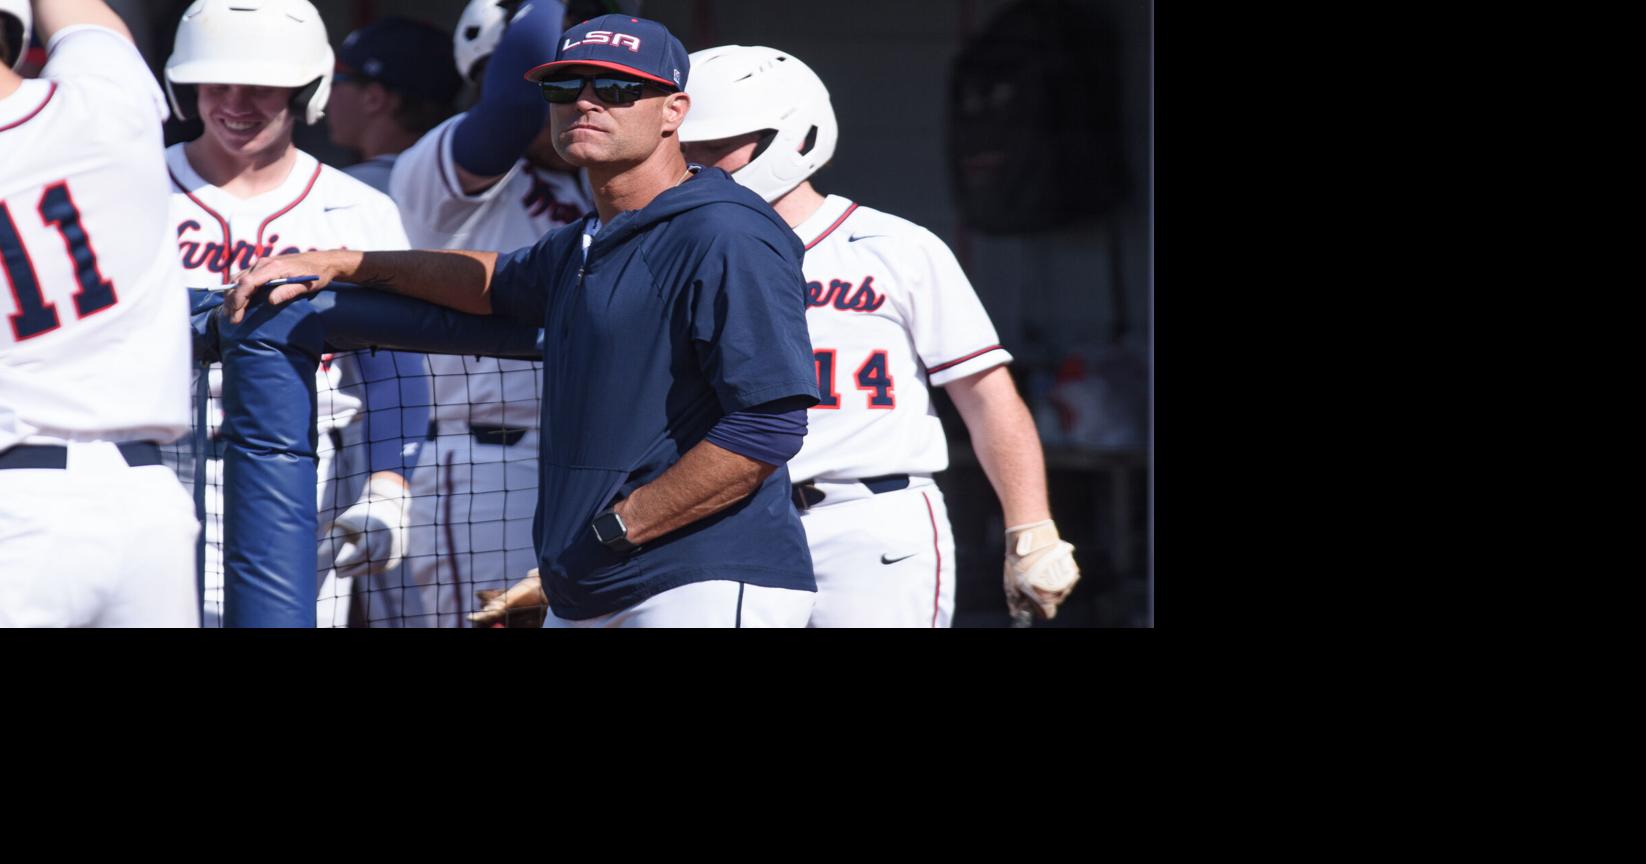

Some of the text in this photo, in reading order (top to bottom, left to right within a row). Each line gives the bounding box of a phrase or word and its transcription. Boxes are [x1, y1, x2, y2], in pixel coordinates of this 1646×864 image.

[562, 30, 641, 52] LSA
[0, 179, 119, 342] 11
[812, 348, 896, 410] 14
